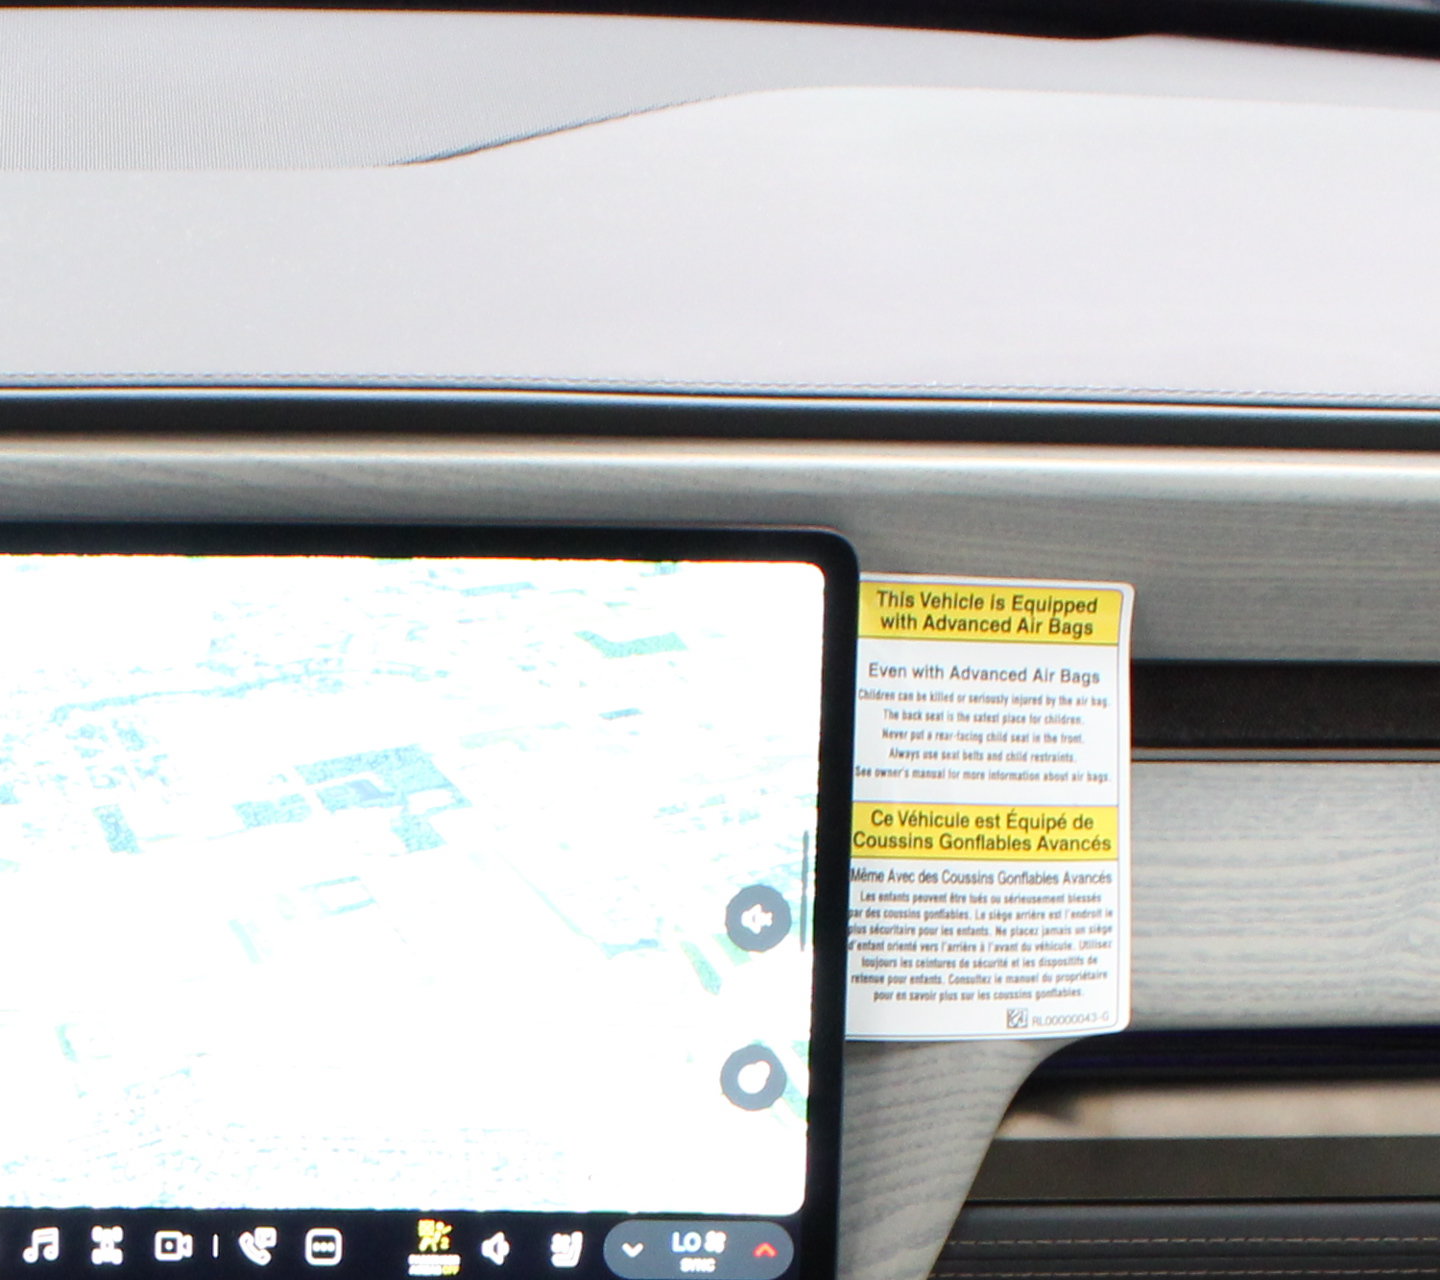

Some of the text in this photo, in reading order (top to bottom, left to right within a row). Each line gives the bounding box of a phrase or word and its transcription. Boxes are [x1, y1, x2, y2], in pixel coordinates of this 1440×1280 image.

[876, 590, 1098, 616] This Vehicle is Equipped
[881, 613, 1094, 640] with Advanced Air Bags
[868, 662, 1101, 688] Even with Advanced Air Bags
[857, 688, 896, 701] Children
[897, 692, 914, 702] can
[915, 691, 927, 702] be
[928, 691, 954, 703] killed
[956, 694, 966, 704] or
[967, 694, 1009, 706] seriously
[1010, 695, 1043, 706] injured
[1044, 695, 1056, 708] by
[1058, 695, 1073, 706] the
[1075, 697, 1088, 707] air
[883, 708, 900, 720] The
[901, 710, 923, 721] back
[924, 712, 944, 722] seat
[946, 711, 954, 722] is
[956, 712, 971, 723] the
[1001, 714, 1027, 725] place
[1028, 713, 1042, 725] for
[881, 728, 908, 740] Never
[909, 730, 925, 742] put
[926, 731, 933, 741] a
[985, 732, 1008, 743] child
[1010, 734, 1030, 744] seat
[1031, 734, 1041, 744] in
[1043, 733, 1058, 744] the
[889, 748, 920, 760] Always
[922, 750, 938, 760] use
[941, 750, 959, 761] seat
[962, 750, 983, 761] belts
[987, 751, 1002, 762] and
[1006, 751, 1027, 762] child
[854, 765, 872, 778] See
[911, 769, 946, 780] manual
[947, 768, 960, 780] for
[961, 771, 986, 780] more
[987, 770, 1041, 782] information
[1042, 772, 1069, 782] about
[1070, 773, 1084, 782] air
[871, 808, 1094, 833] Ce Véhicule est Équipé de
[852, 831, 1111, 852] Coussins Gonflables Avancés
[851, 867, 1112, 886] Même Avec des Coussins Gonflables Avancés
[860, 891, 876, 902] Les
[878, 892, 910, 903] enfants
[912, 894, 947, 904] peuvent
[949, 892, 966, 904] être
[990, 895, 1001, 905] ou
[1067, 894, 1101, 904] blessés
[864, 907, 881, 919] des
[883, 909, 921, 920] coussins
[974, 909, 986, 920] Le
[988, 910, 1012, 922] siège
[1015, 910, 1046, 920] arrière
[1048, 910, 1062, 920] est
[1104, 909, 1113, 918] le
[918, 926, 937, 938] pour
[941, 926, 953, 936] les
[995, 926, 1006, 936] Ne
[1010, 927, 1038, 938] placez
[1042, 927, 1071, 937] jamais
[1075, 926, 1085, 935] un
[1089, 925, 1112, 936] siège
[886, 941, 917, 952] orienté
[919, 943, 938, 952] vers
[979, 942, 985, 953] à
[1020, 942, 1032, 952] du
[900, 958, 913, 968] les
[915, 958, 956, 969] ceintures
[958, 958, 969, 969] de
[972, 958, 1008, 969] sécurité
[1011, 958, 1019, 968] et
[1022, 958, 1035, 968] les
[1087, 955, 1097, 966] de
[850, 974, 884, 984] retenue
[887, 975, 907, 986] pour
[994, 975, 1002, 984] le
[1005, 974, 1038, 984] manuel
[1042, 973, 1052, 984] du
[873, 991, 893, 1002] pour
[895, 992, 906, 1001] en
[909, 992, 936, 1001] savoir
[939, 990, 958, 1003] plus
[960, 992, 974, 1001] sur
[977, 991, 990, 1001] les
[993, 991, 1032, 1000] coussins
[671, 1231, 702, 1253] LO
